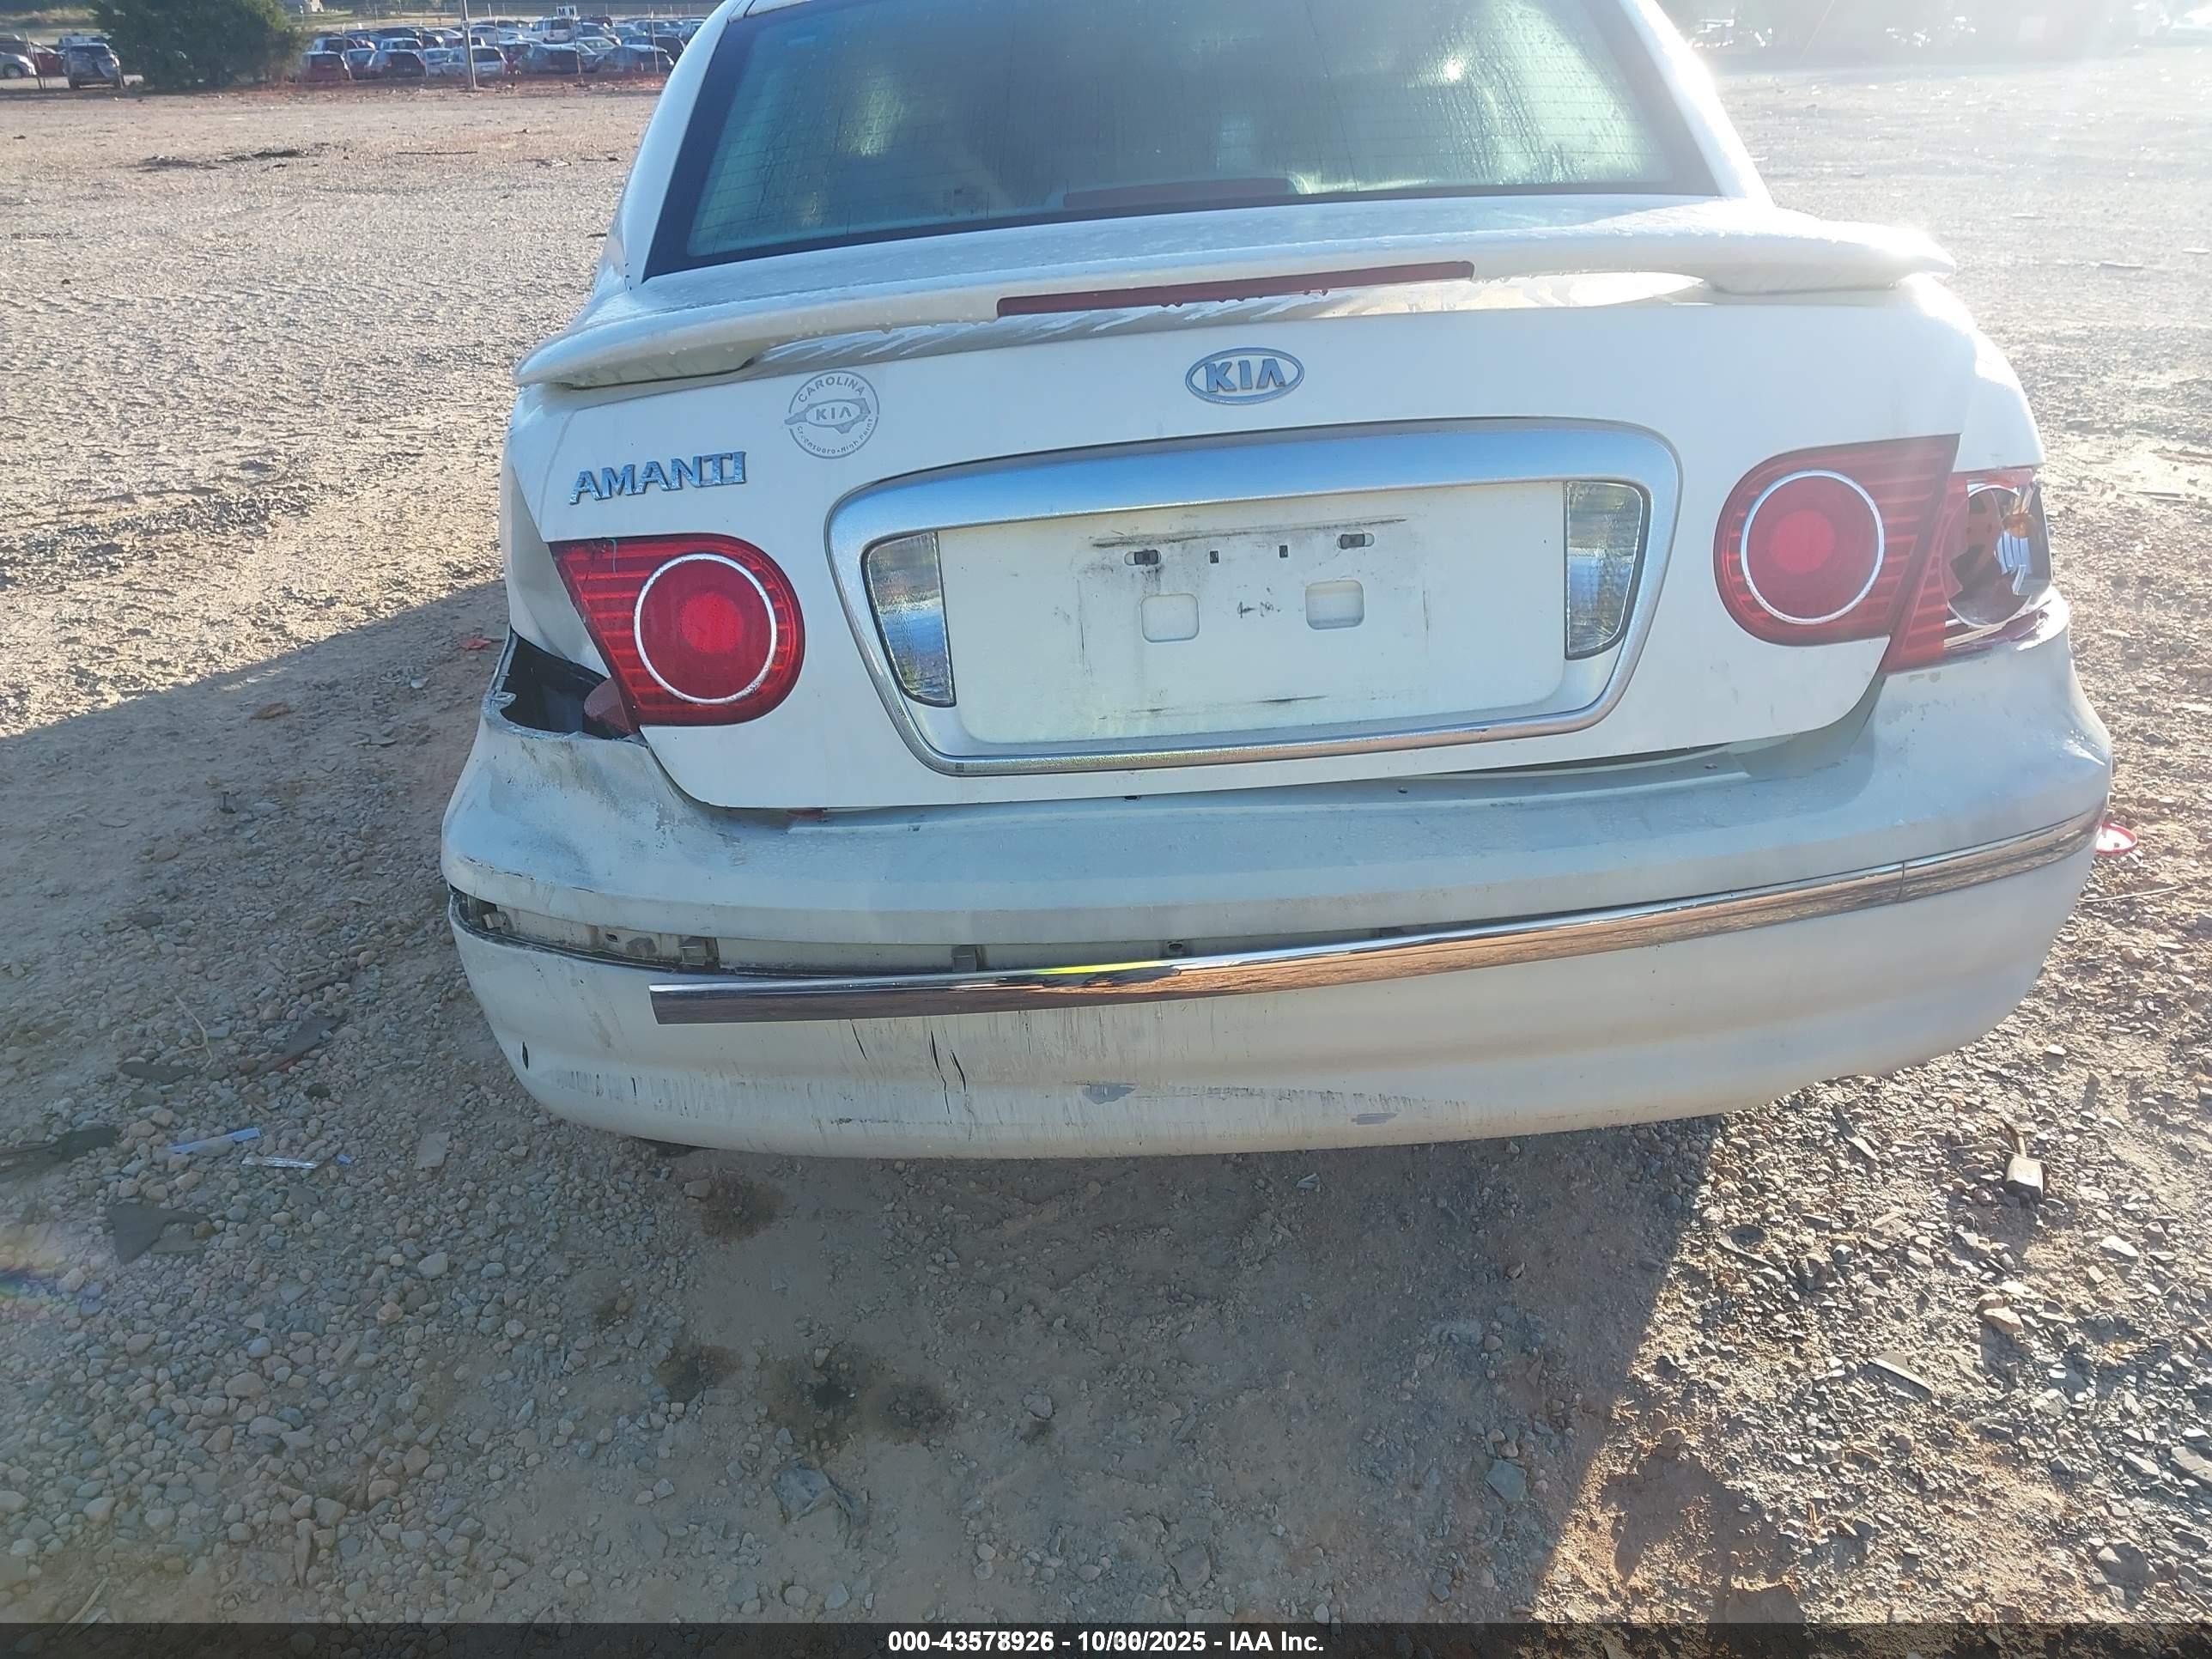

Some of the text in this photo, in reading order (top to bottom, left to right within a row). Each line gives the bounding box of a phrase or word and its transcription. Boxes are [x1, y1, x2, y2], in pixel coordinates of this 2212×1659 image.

[798, 376, 865, 403] CAROLINA
[1205, 358, 1286, 393] KIA
[816, 406, 852, 421] KIA
[568, 451, 747, 505] AMANTI
